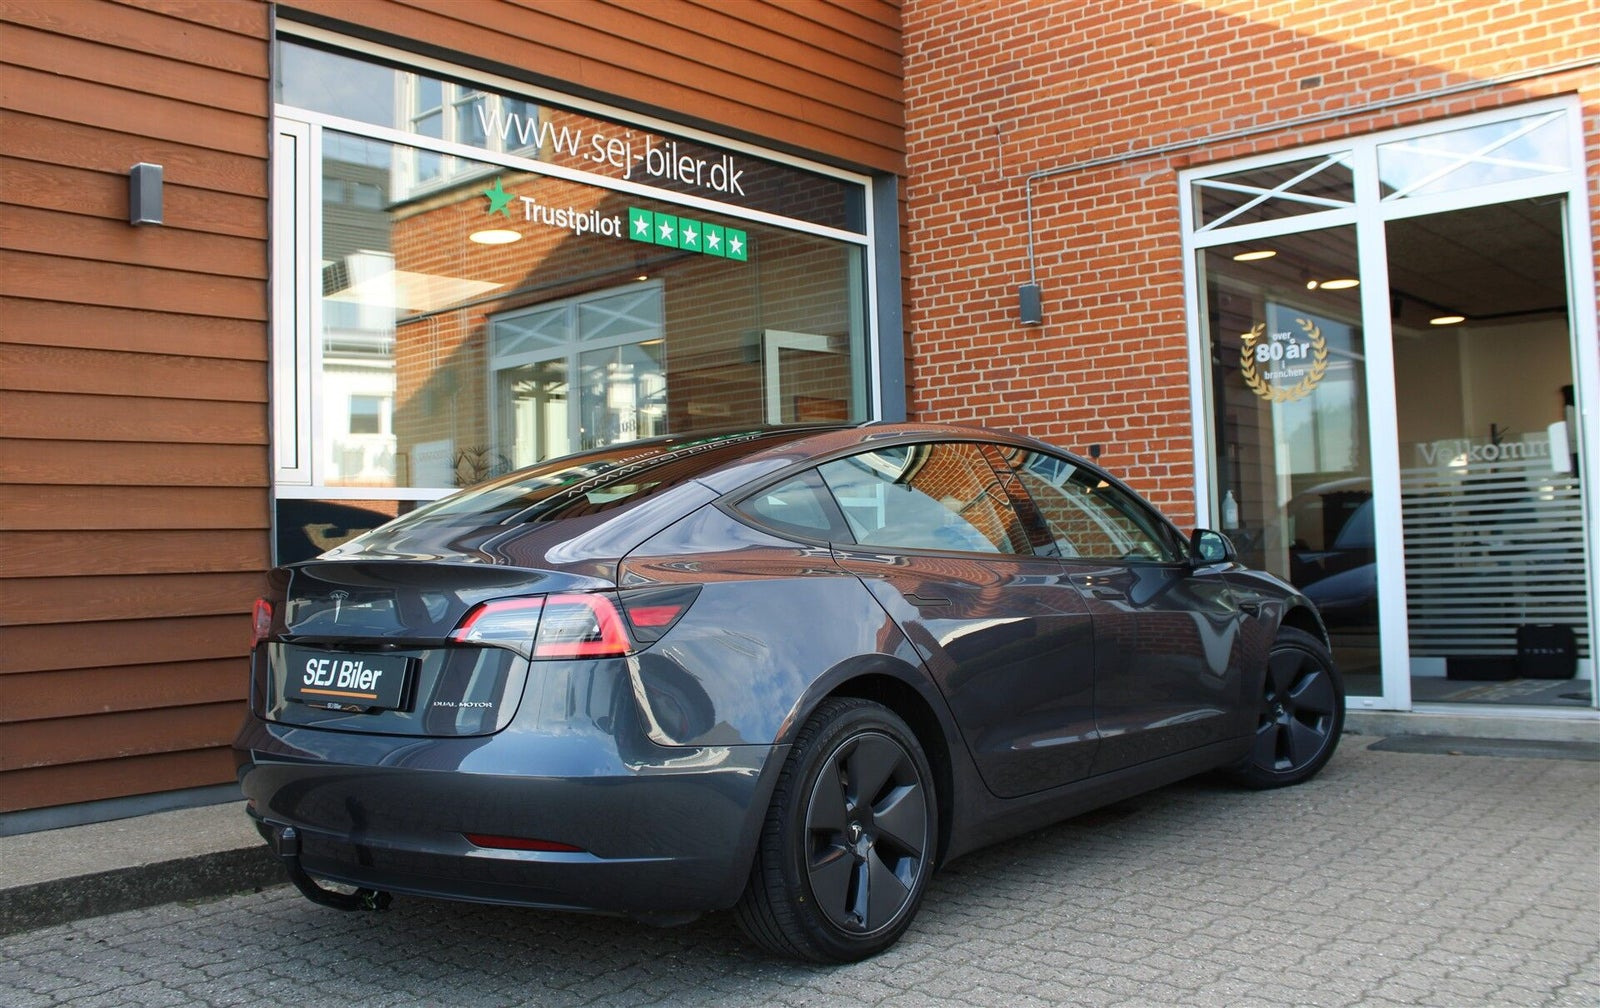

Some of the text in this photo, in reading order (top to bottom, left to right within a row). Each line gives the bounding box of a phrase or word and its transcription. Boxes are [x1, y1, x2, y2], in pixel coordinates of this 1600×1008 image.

[477, 104, 745, 197] www.sej-biler.dk
[519, 195, 622, 238] Trustpilot
[1272, 331, 1292, 341] over
[1256, 338, 1310, 362] 80 år
[1264, 368, 1304, 380] branchen
[1417, 438, 1550, 465] Velkomm
[303, 658, 382, 690] SEJ Biler
